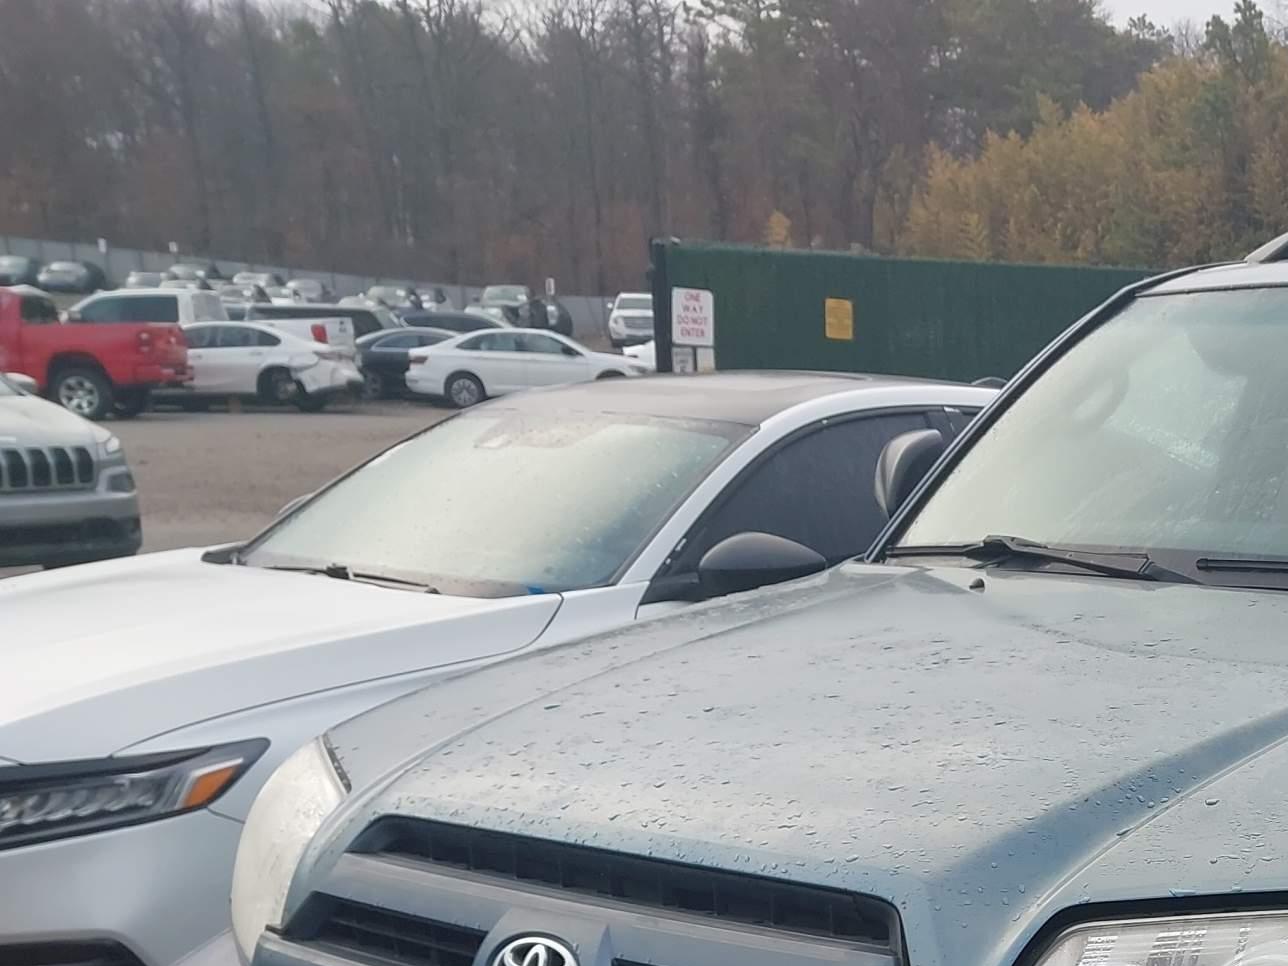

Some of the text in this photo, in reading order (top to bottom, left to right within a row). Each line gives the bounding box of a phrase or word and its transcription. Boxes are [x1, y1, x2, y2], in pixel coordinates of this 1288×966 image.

[684, 291, 701, 303] ONE
[682, 304, 704, 314] WAY
[677, 314, 707, 326] DO NOT
[680, 327, 705, 337] ENTER
